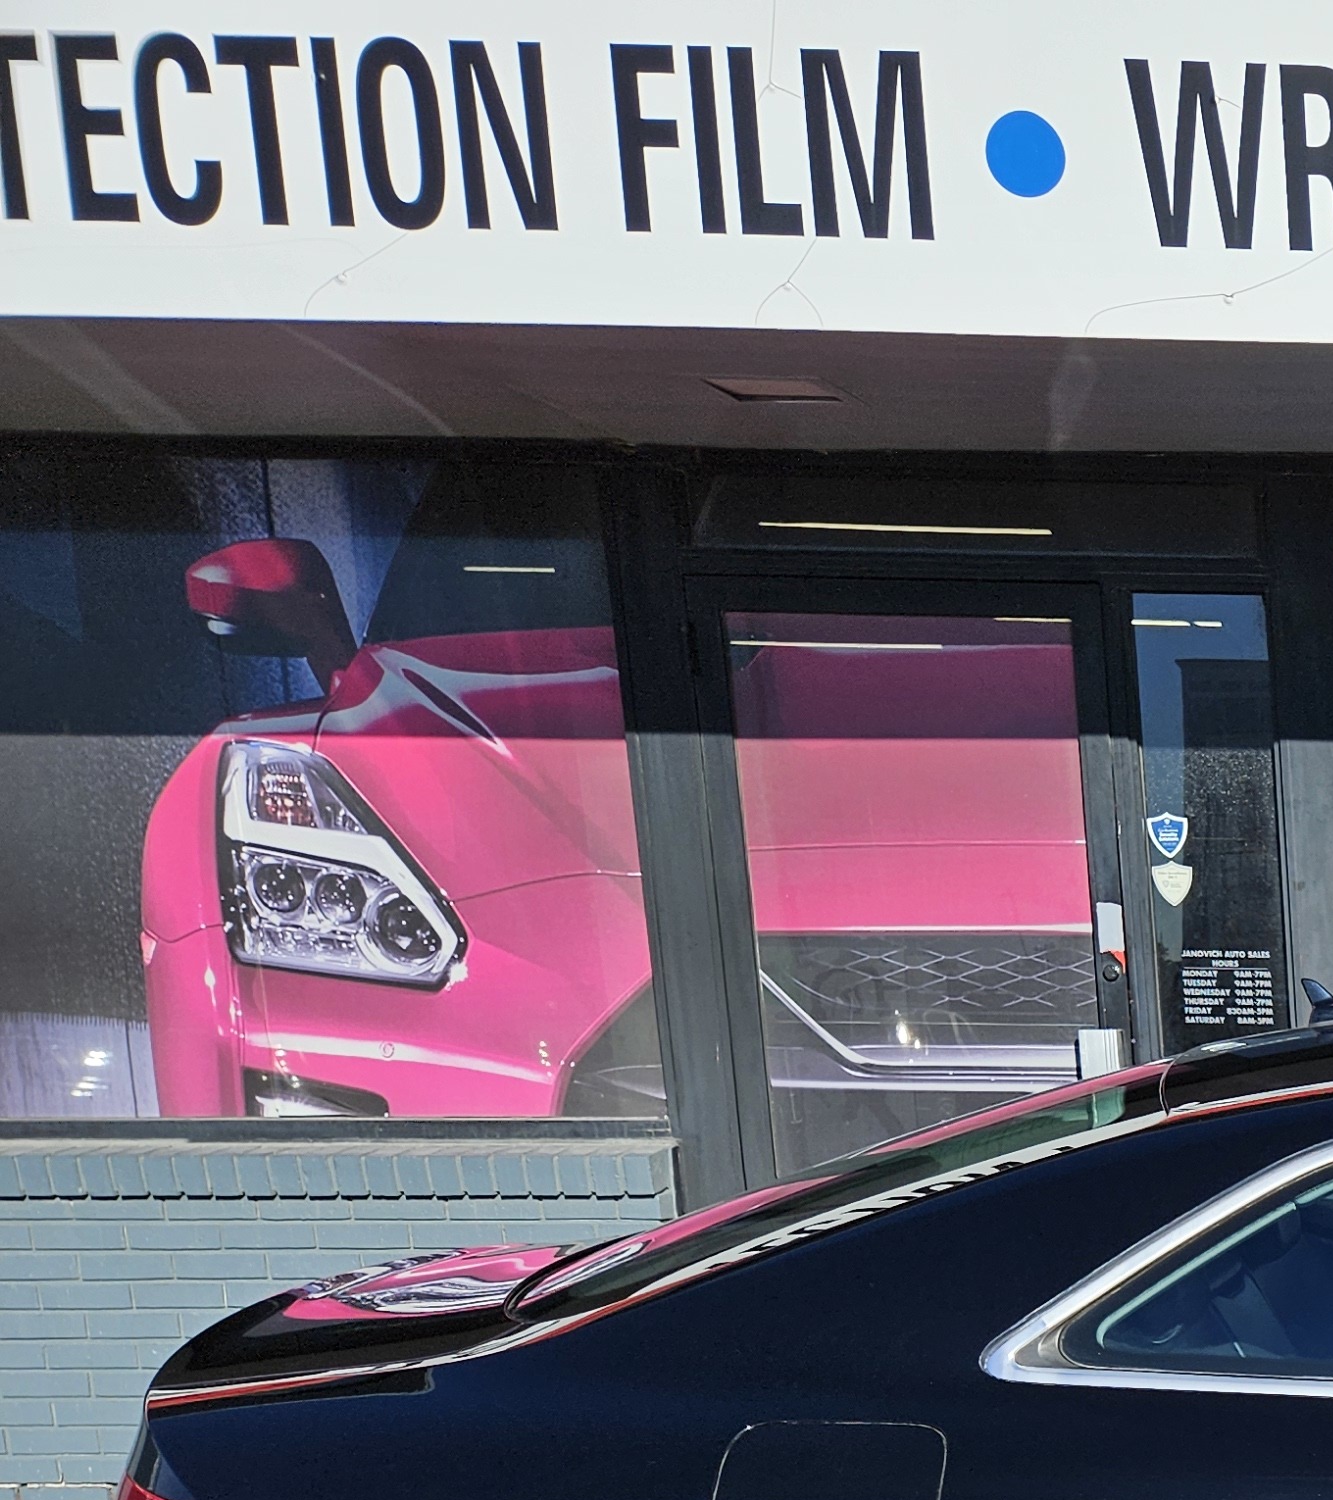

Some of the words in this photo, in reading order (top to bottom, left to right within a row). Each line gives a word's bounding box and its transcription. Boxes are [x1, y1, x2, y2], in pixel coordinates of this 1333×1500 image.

[0, 29, 560, 232] TECTION
[608, 42, 936, 241] FILM
[1181, 949, 1223, 958] JANOVICH
[1224, 950, 1246, 959] AUTO
[1247, 950, 1271, 959] SALES
[1211, 959, 1240, 968] HOURS
[1182, 970, 1219, 978] MONDAY
[1233, 970, 1272, 979] 9AM-7PM
[1182, 979, 1217, 987] TUESDAY
[1233, 979, 1273, 988] 9AM-7PM
[1183, 988, 1231, 997] WEDNESDAY
[1234, 988, 1273, 997] 9AM-7PM
[1184, 997, 1225, 1006] THURSDAY
[1234, 997, 1273, 1007] 9AM-7PM
[1184, 1006, 1213, 1015] FRIDAY
[1184, 1016, 1226, 1025] SATURDAY
